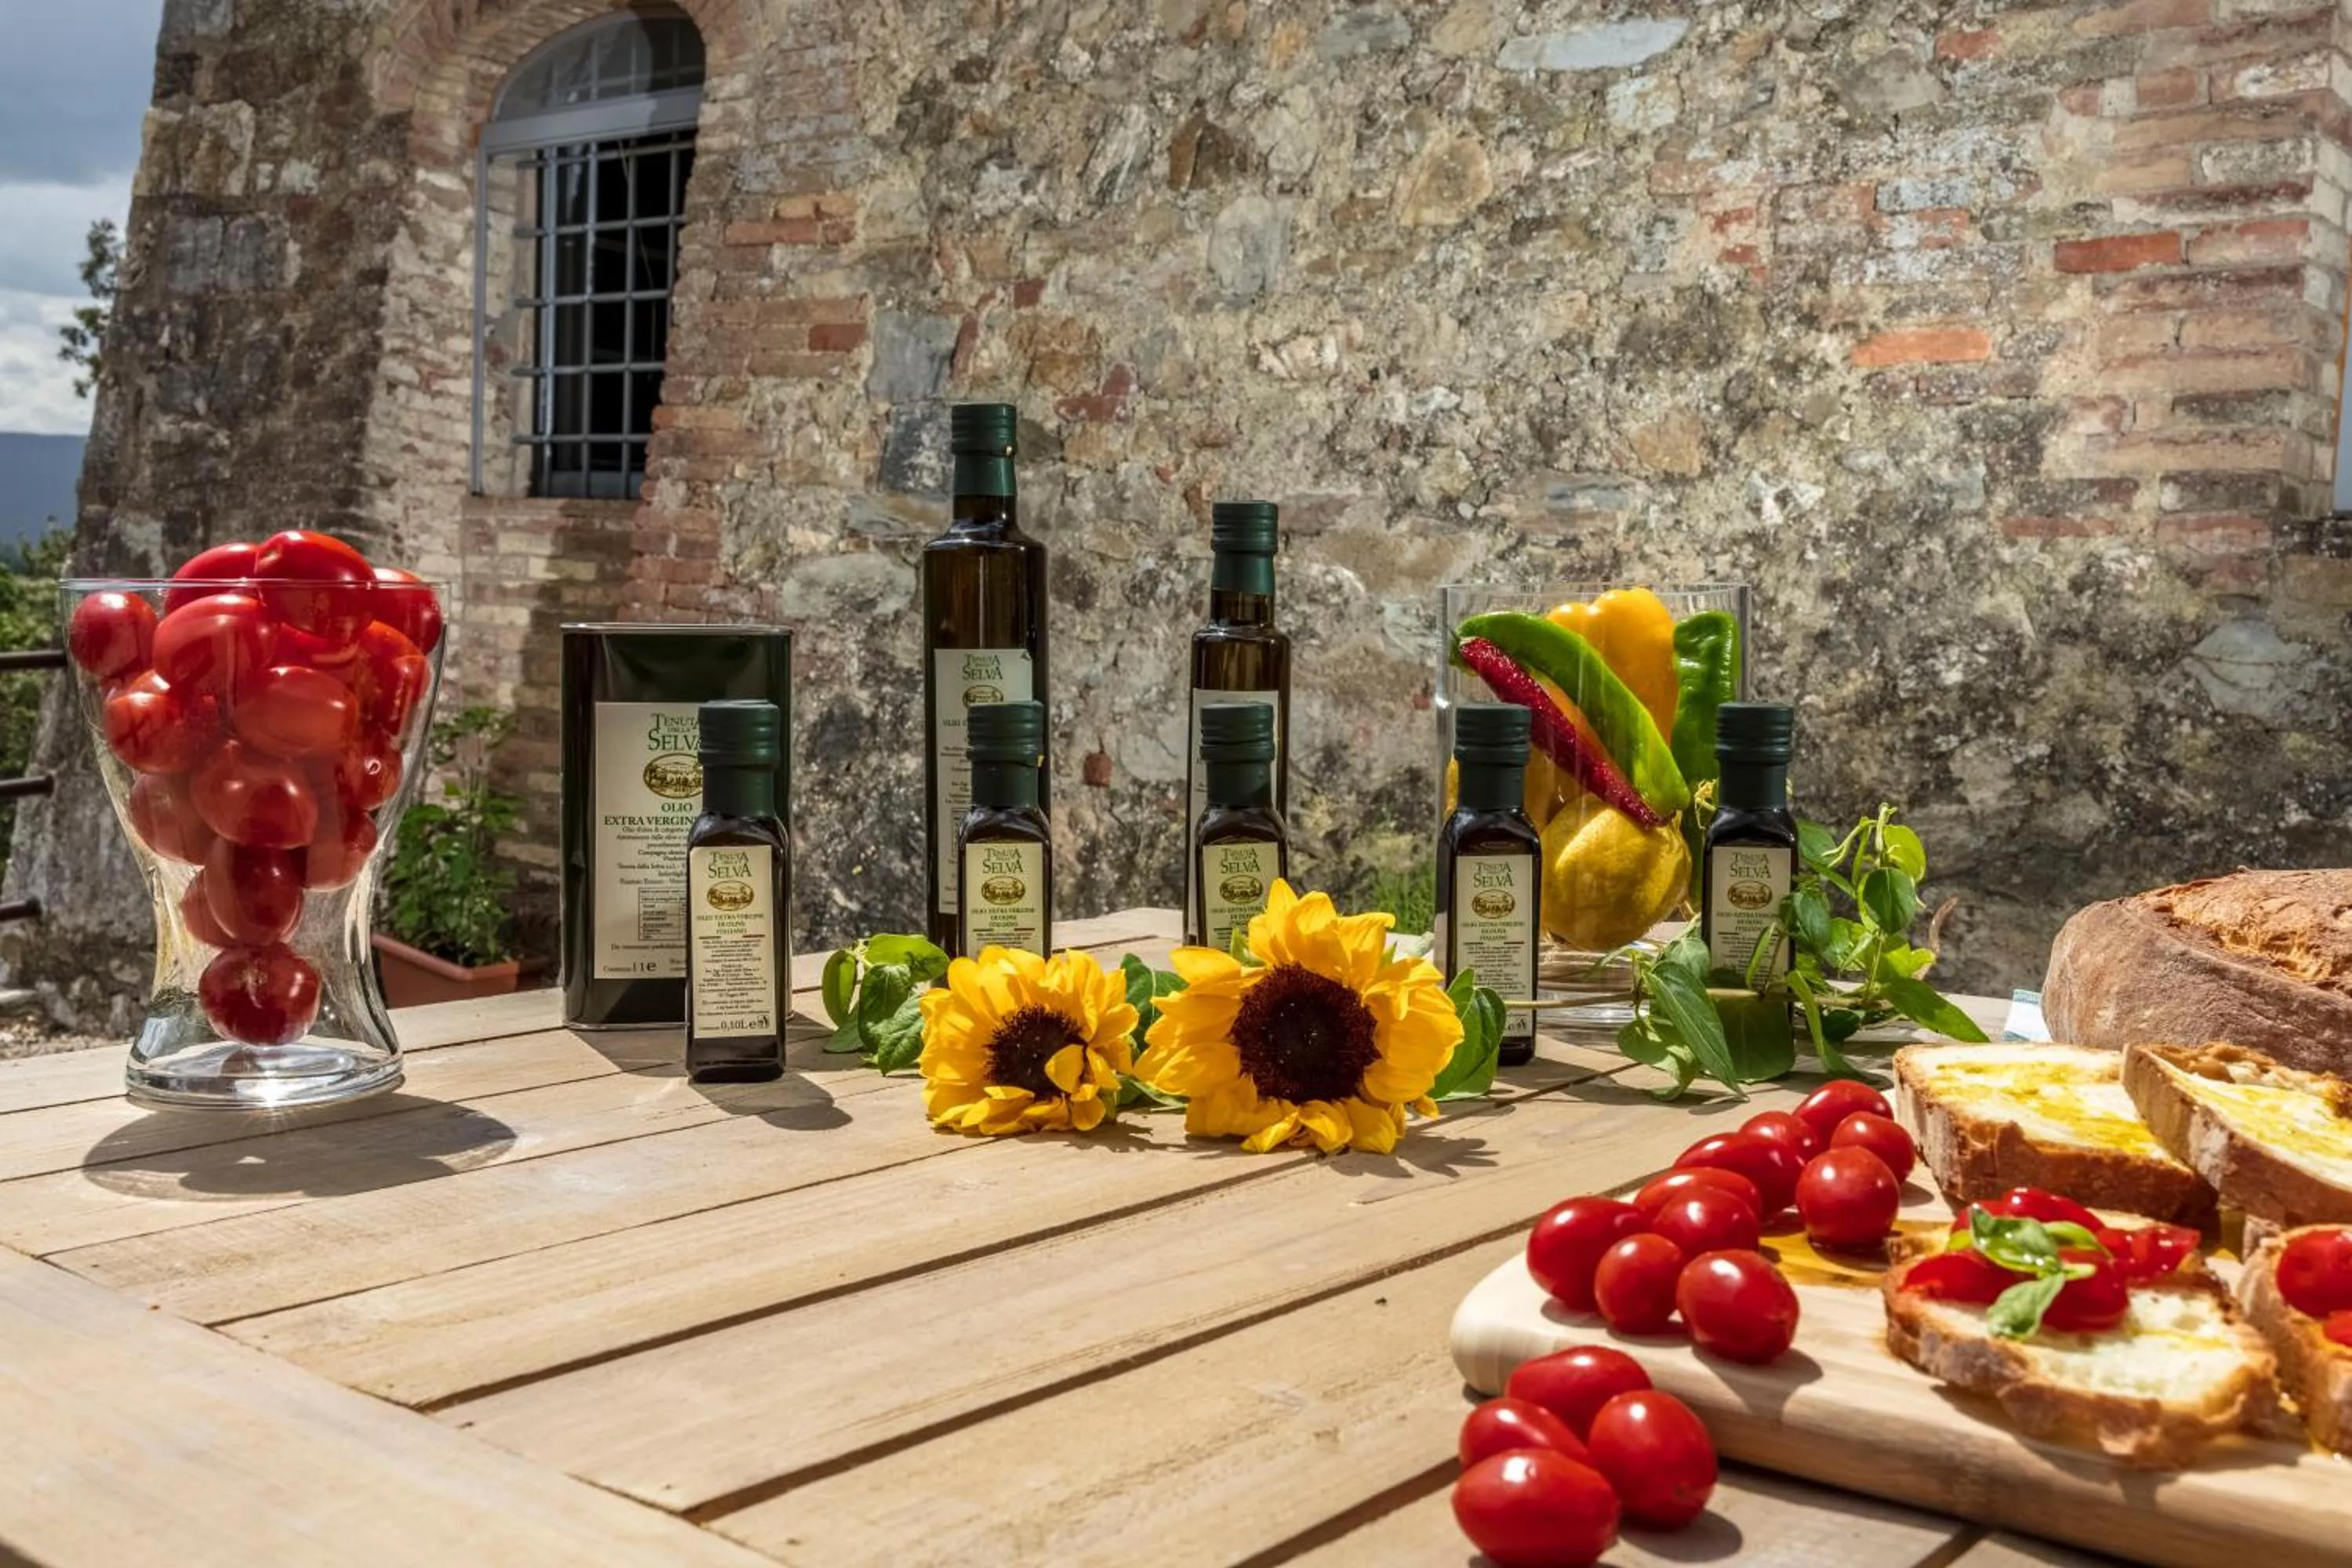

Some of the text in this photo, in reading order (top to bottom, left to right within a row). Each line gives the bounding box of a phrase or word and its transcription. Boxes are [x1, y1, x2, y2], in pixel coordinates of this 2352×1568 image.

[963, 666, 1003, 681] SELVA
[661, 802, 693, 812] OLIO
[604, 815, 644, 825] EXTRA
[708, 862, 752, 878] SELVA
[982, 859, 1023, 873] SELVA
[1221, 859, 1260, 873] SELVA
[1730, 863, 1771, 878] SELVA
[1474, 873, 1513, 887] SELVA
